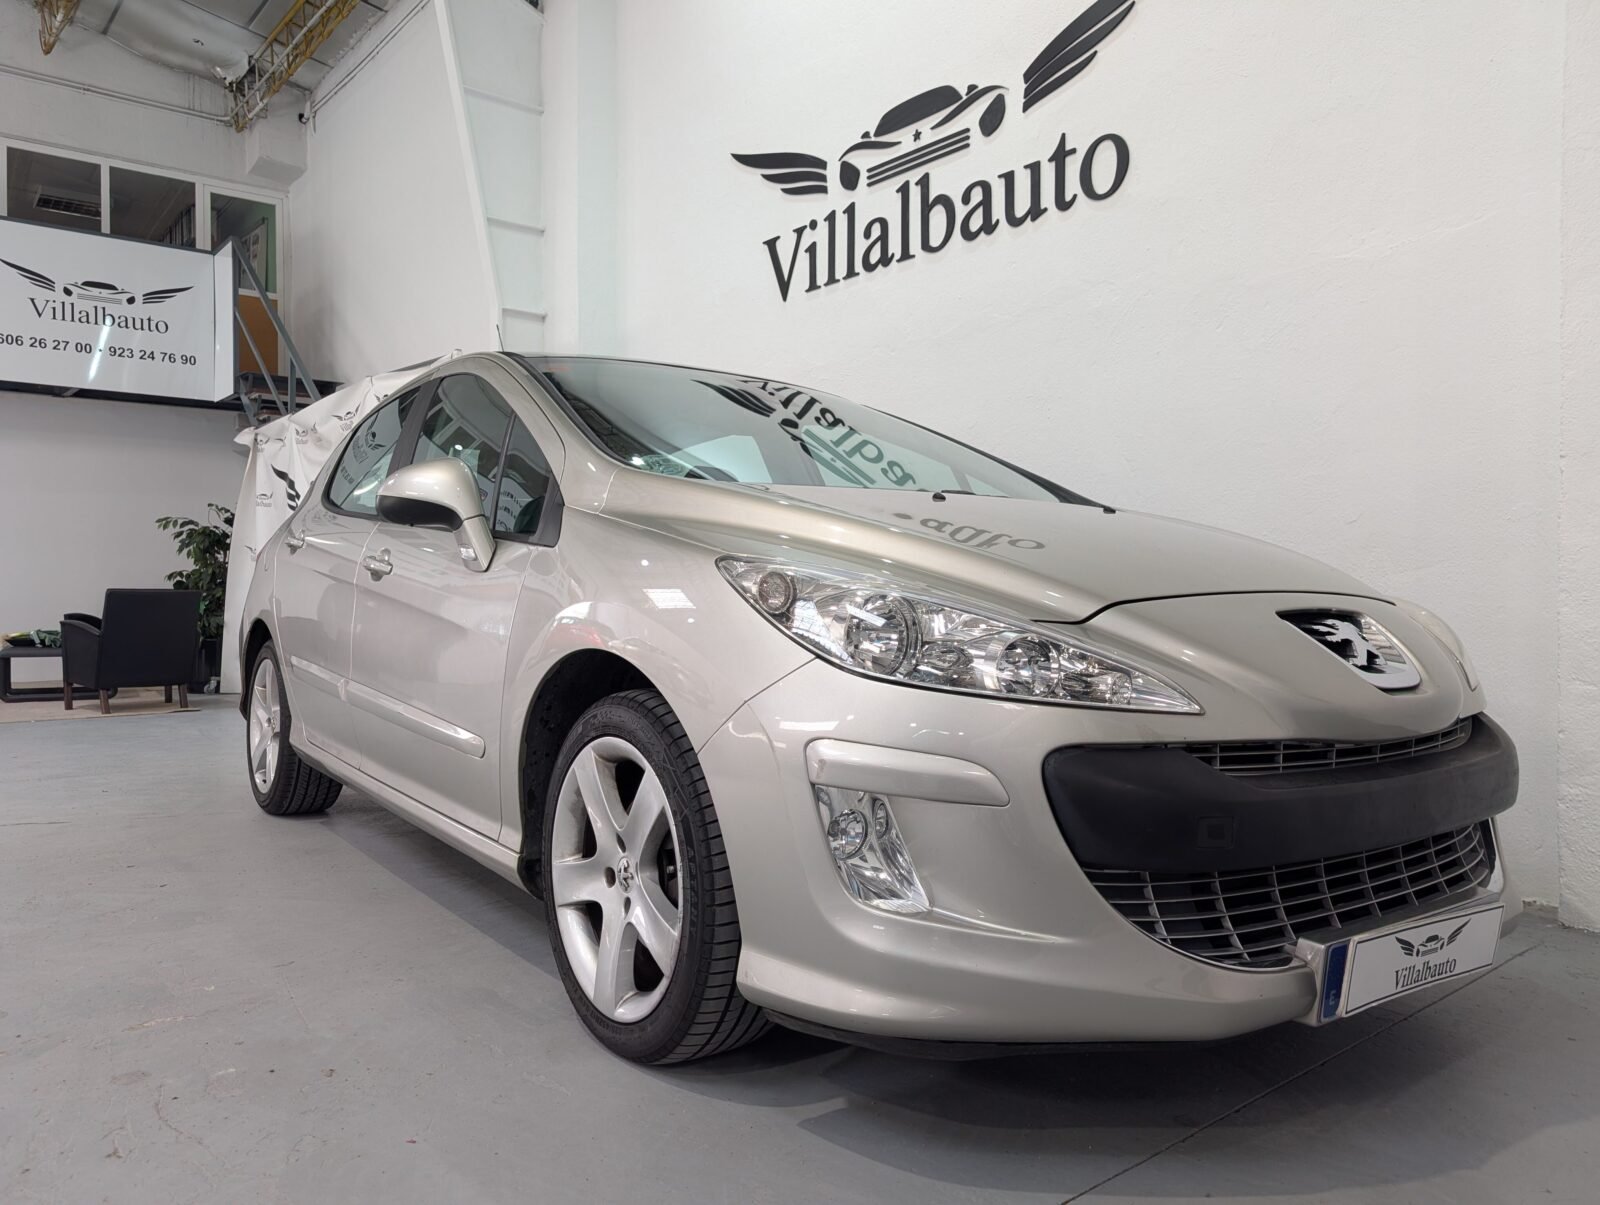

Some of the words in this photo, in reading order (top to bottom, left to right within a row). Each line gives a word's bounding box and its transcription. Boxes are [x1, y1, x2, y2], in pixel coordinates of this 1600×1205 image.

[763, 132, 1131, 302] Villalbauto
[28, 297, 169, 334] Villalbauto
[29, 337, 48, 349] 26
[52, 339, 70, 351] 27
[75, 342, 92, 354] 00
[108, 346, 135, 359] 923
[139, 349, 156, 361] 24
[160, 352, 177, 364] 76
[180, 354, 197, 366] 90
[1394, 957, 1457, 990] Villalbauto
